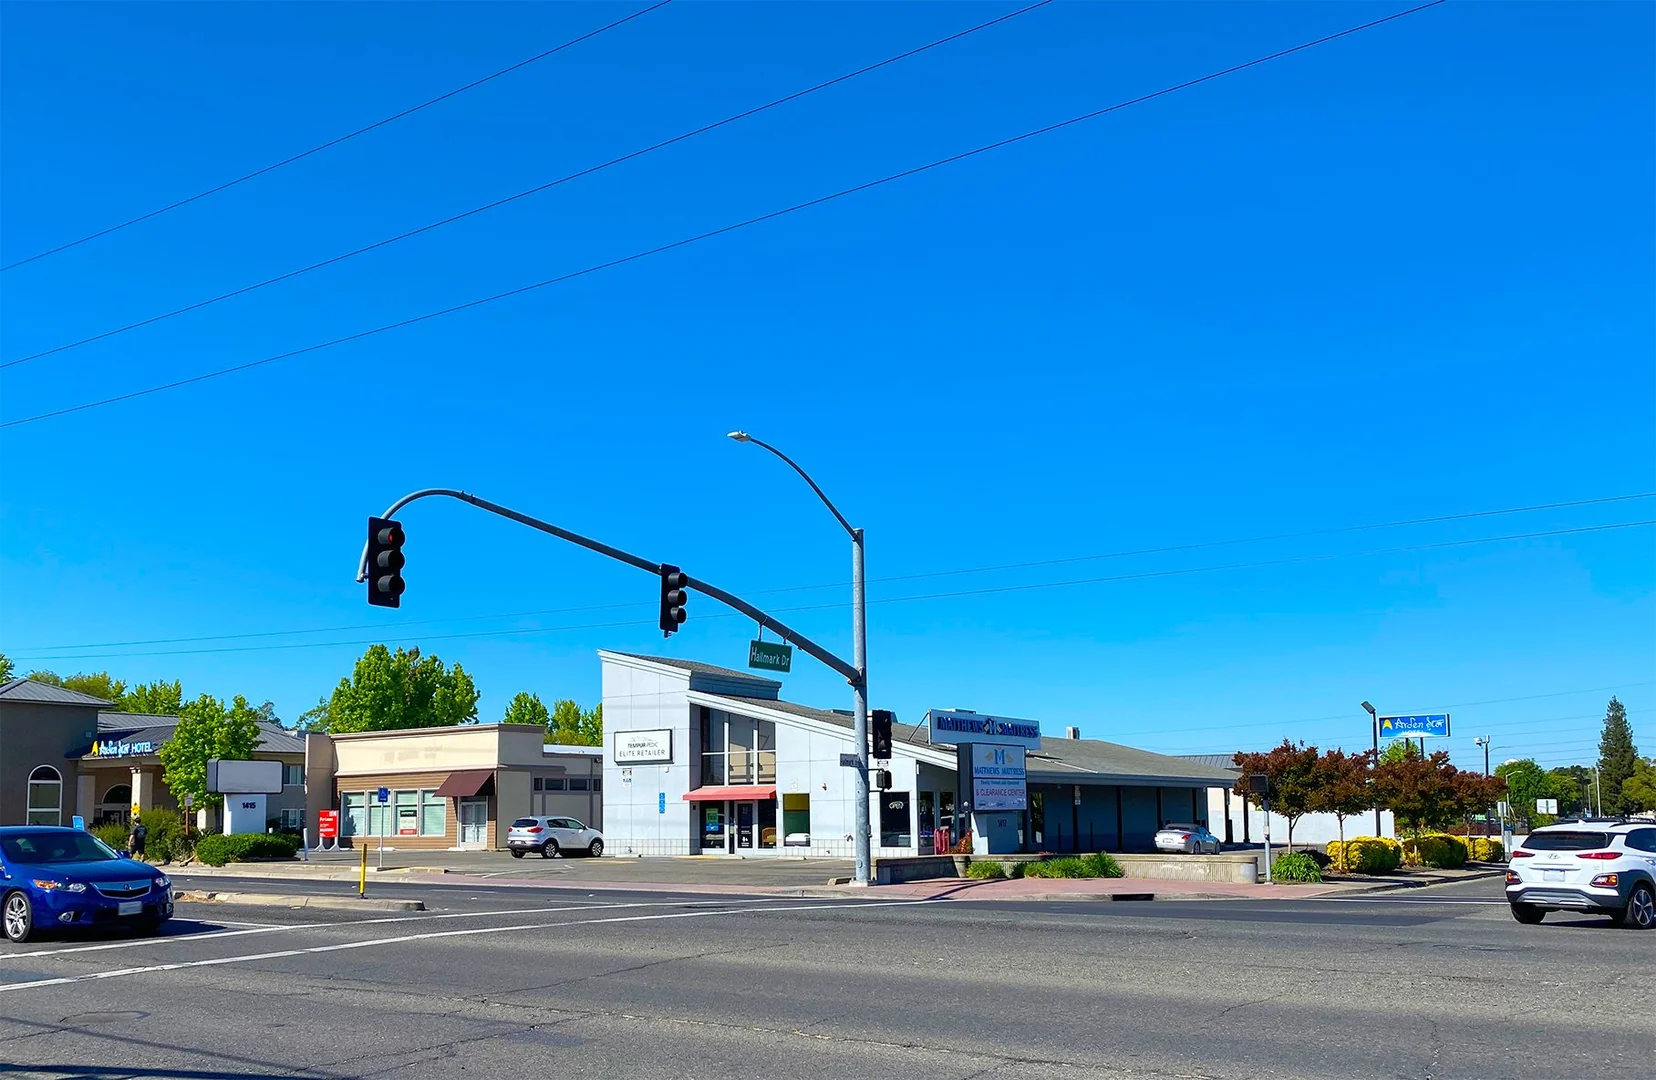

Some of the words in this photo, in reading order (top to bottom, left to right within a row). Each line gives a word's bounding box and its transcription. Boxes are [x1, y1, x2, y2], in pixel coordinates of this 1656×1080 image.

[751, 646, 780, 665] Hallmark
[781, 654, 790, 666] Dr
[937, 716, 984, 733] MATTHEWS
[1001, 722, 1038, 738] MATTRESS
[1395, 717, 1424, 729] Arden
[1426, 716, 1445, 731] Star
[131, 741, 152, 753] HOTEL
[975, 766, 1000, 775] MATTHEWS
[1001, 767, 1024, 776] MATTRESS
[980, 788, 1007, 797] CLEARANCE
[1008, 788, 1024, 797] CENTER
